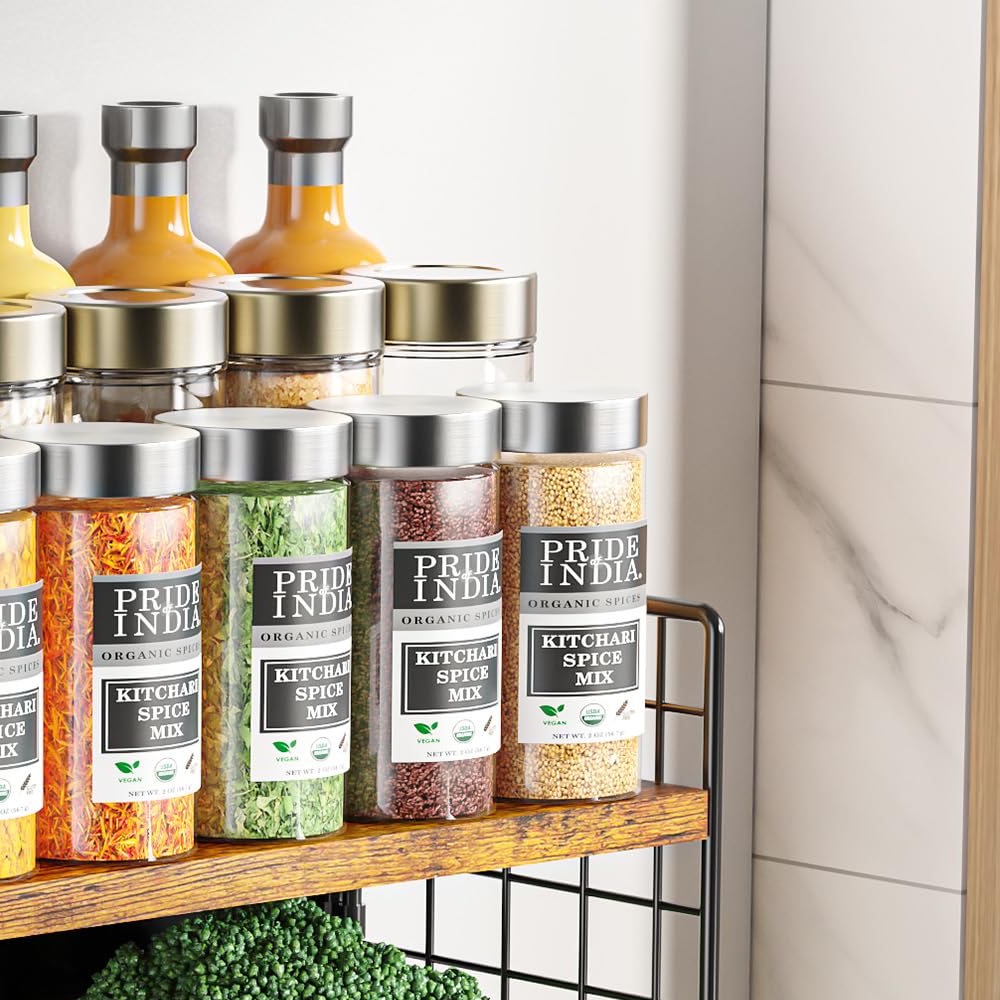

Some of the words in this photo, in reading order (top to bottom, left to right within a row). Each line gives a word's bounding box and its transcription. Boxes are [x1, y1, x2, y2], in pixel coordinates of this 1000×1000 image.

[540, 535, 639, 562] PRIDE
[414, 548, 499, 578] PRIDE
[114, 580, 199, 612] PRIDE
[528, 600, 600, 608] ORGANIC
[605, 594, 640, 606] SPICES
[402, 614, 470, 625] ORGANIC
[261, 630, 328, 641] ORGANIC
[542, 629, 636, 648] KITCHARI
[102, 649, 171, 660] ORGANIC
[415, 643, 497, 666] KITCHARI
[563, 651, 622, 668] SPICE
[436, 665, 489, 684] SPICE
[575, 670, 614, 686] MIX
[116, 679, 198, 703] KITCHARI
[295, 682, 343, 701] SPICE
[448, 686, 482, 702] MIX
[138, 701, 190, 722] SPICE
[306, 702, 338, 720] MIX
[150, 722, 184, 740] MIX
